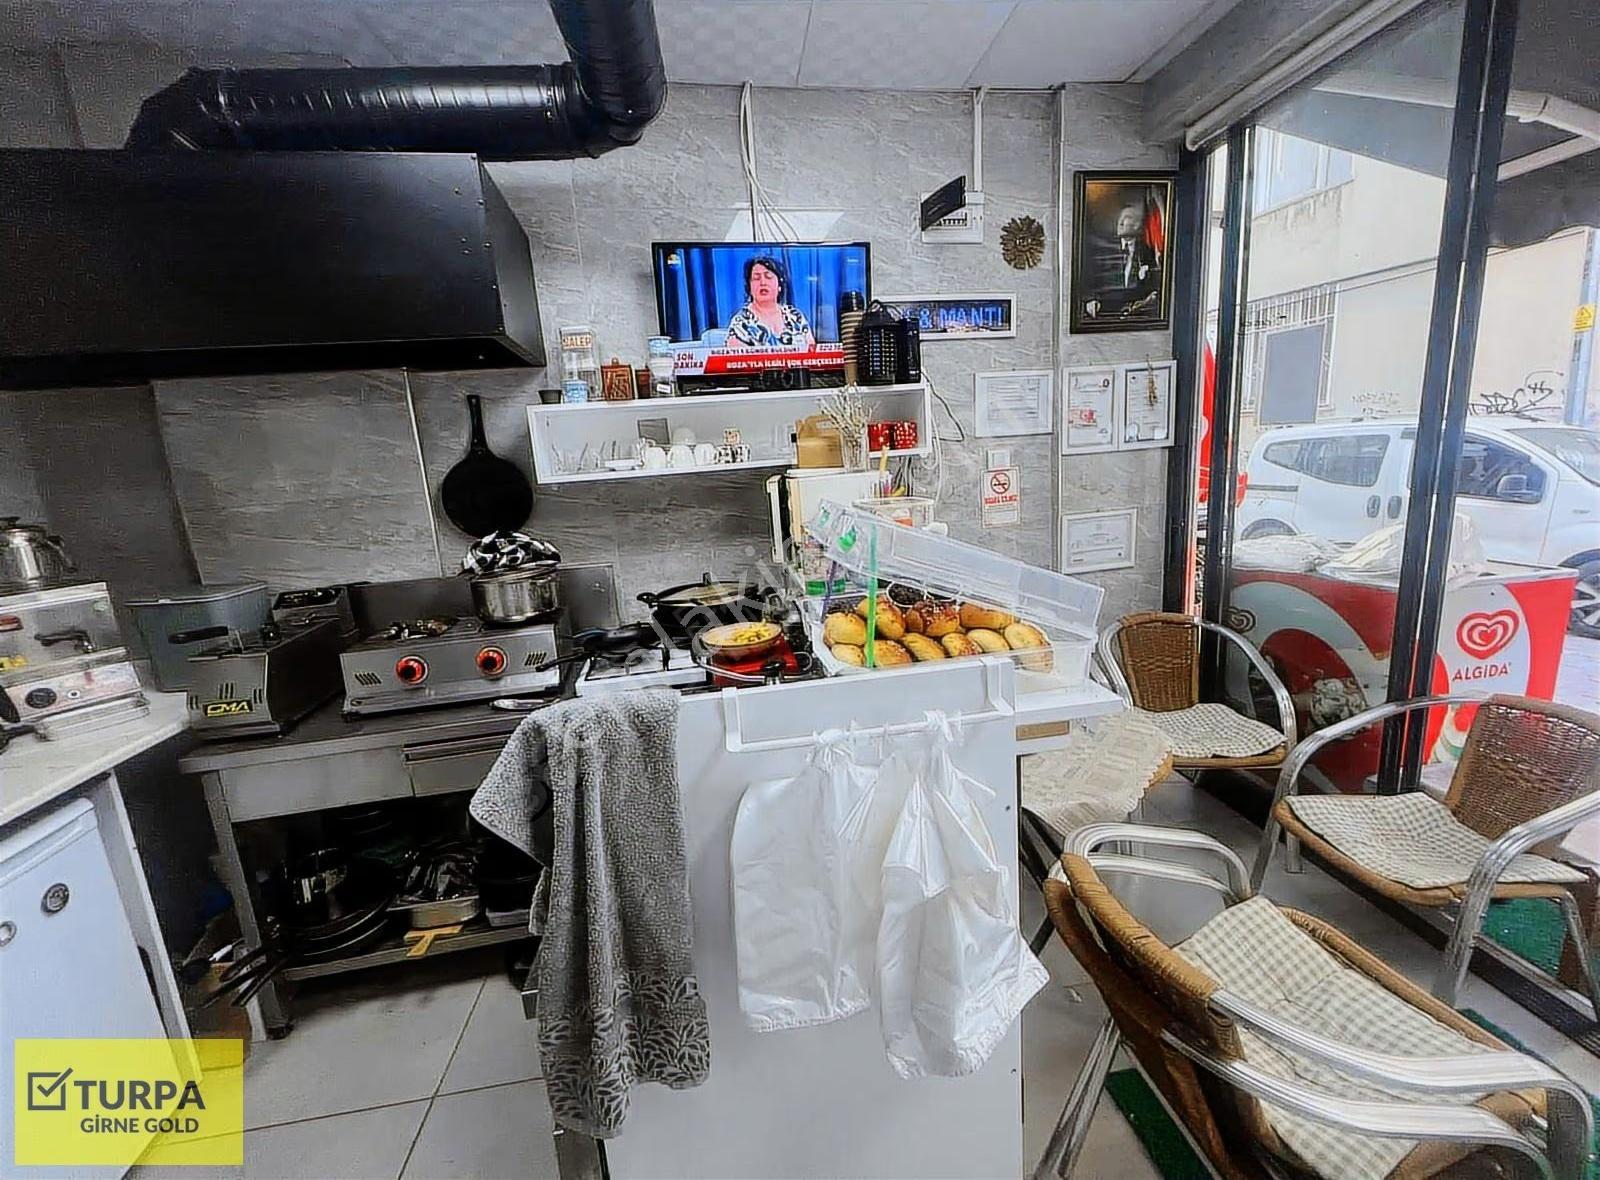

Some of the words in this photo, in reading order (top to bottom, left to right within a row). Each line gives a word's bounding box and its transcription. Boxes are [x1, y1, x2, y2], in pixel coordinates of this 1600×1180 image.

[919, 307, 933, 329] &
[676, 352, 694, 361] SON
[1452, 662, 1509, 682] ALGIDA
